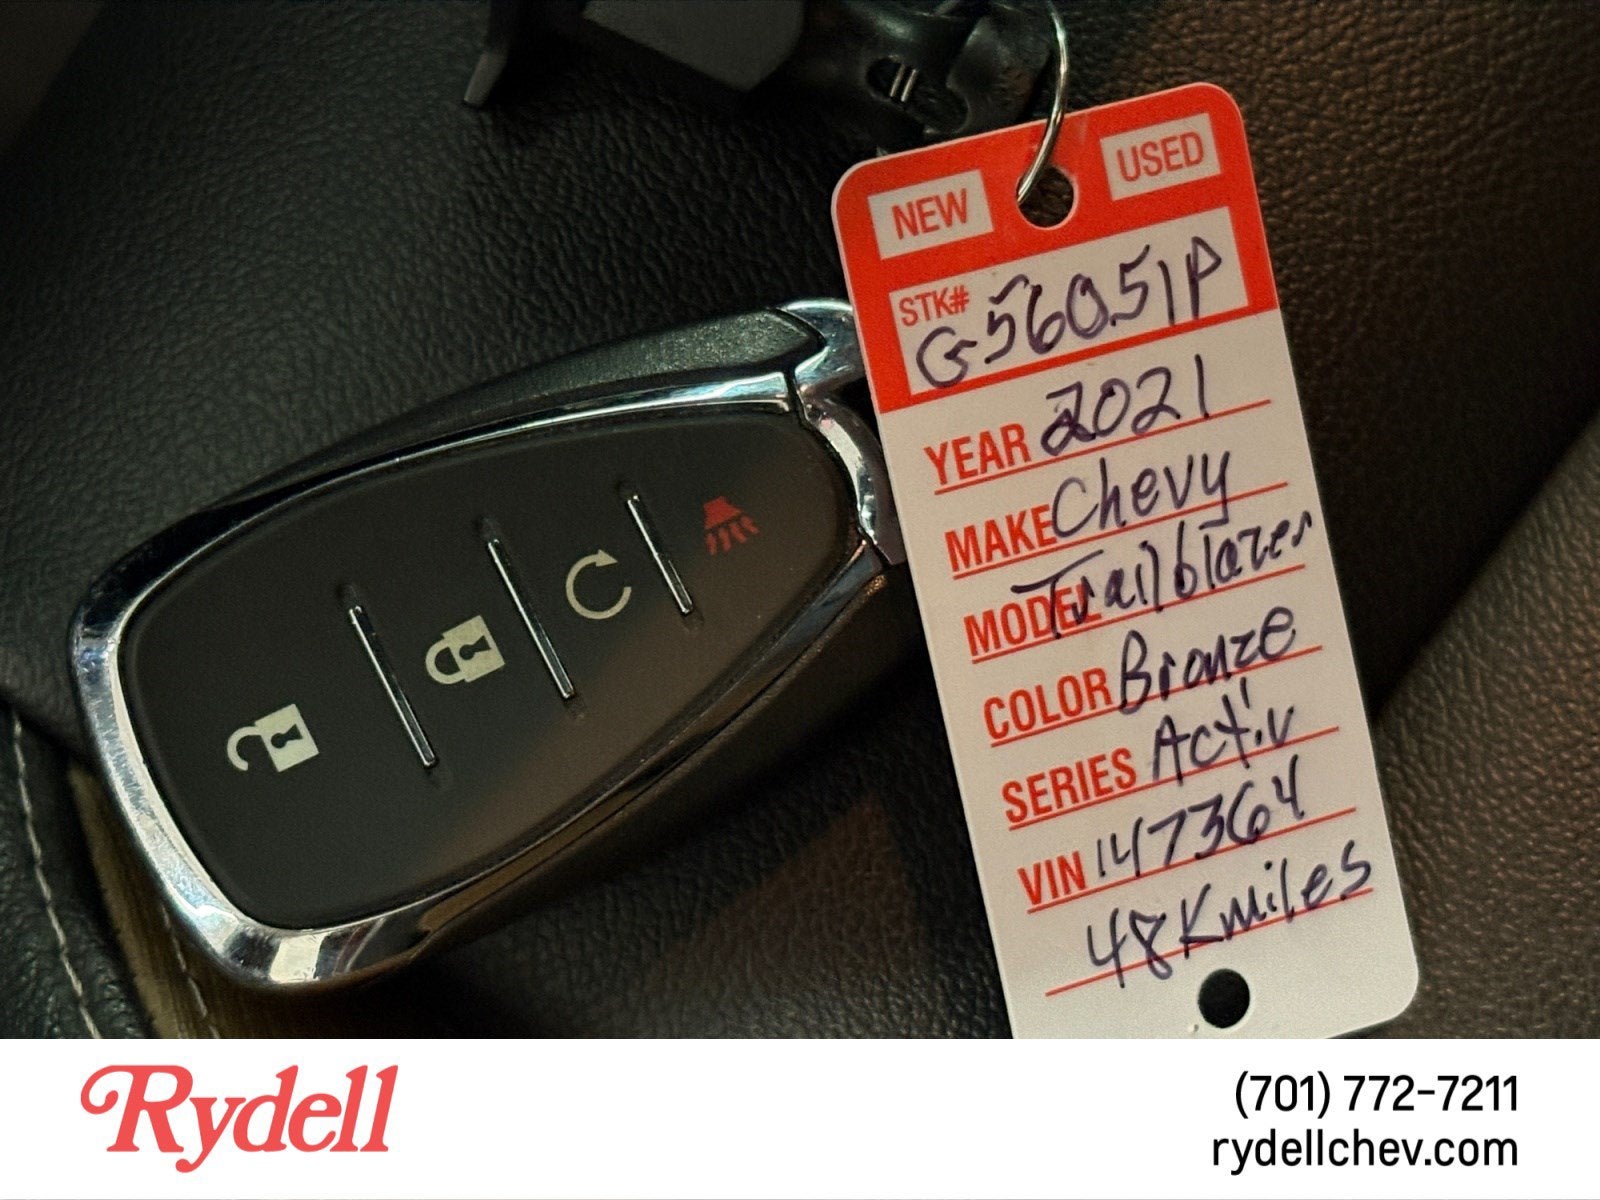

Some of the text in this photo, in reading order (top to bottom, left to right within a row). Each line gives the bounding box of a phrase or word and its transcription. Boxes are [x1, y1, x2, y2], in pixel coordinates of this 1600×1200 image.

[1116, 131, 1206, 183] USED
[892, 188, 970, 240] NEW
[899, 285, 970, 327] STK#
[1040, 354, 1210, 456] 2021
[924, 423, 1032, 486] YEAR
[1051, 451, 1231, 539] Chevy
[944, 503, 1058, 573] MAKE
[963, 583, 1102, 657] MODEL
[1117, 606, 1297, 715] Bronze
[983, 667, 1113, 741] COLOR
[1002, 747, 1137, 824] SERIES
[1096, 754, 1305, 877] 147364
[1017, 851, 1087, 905] VIN
